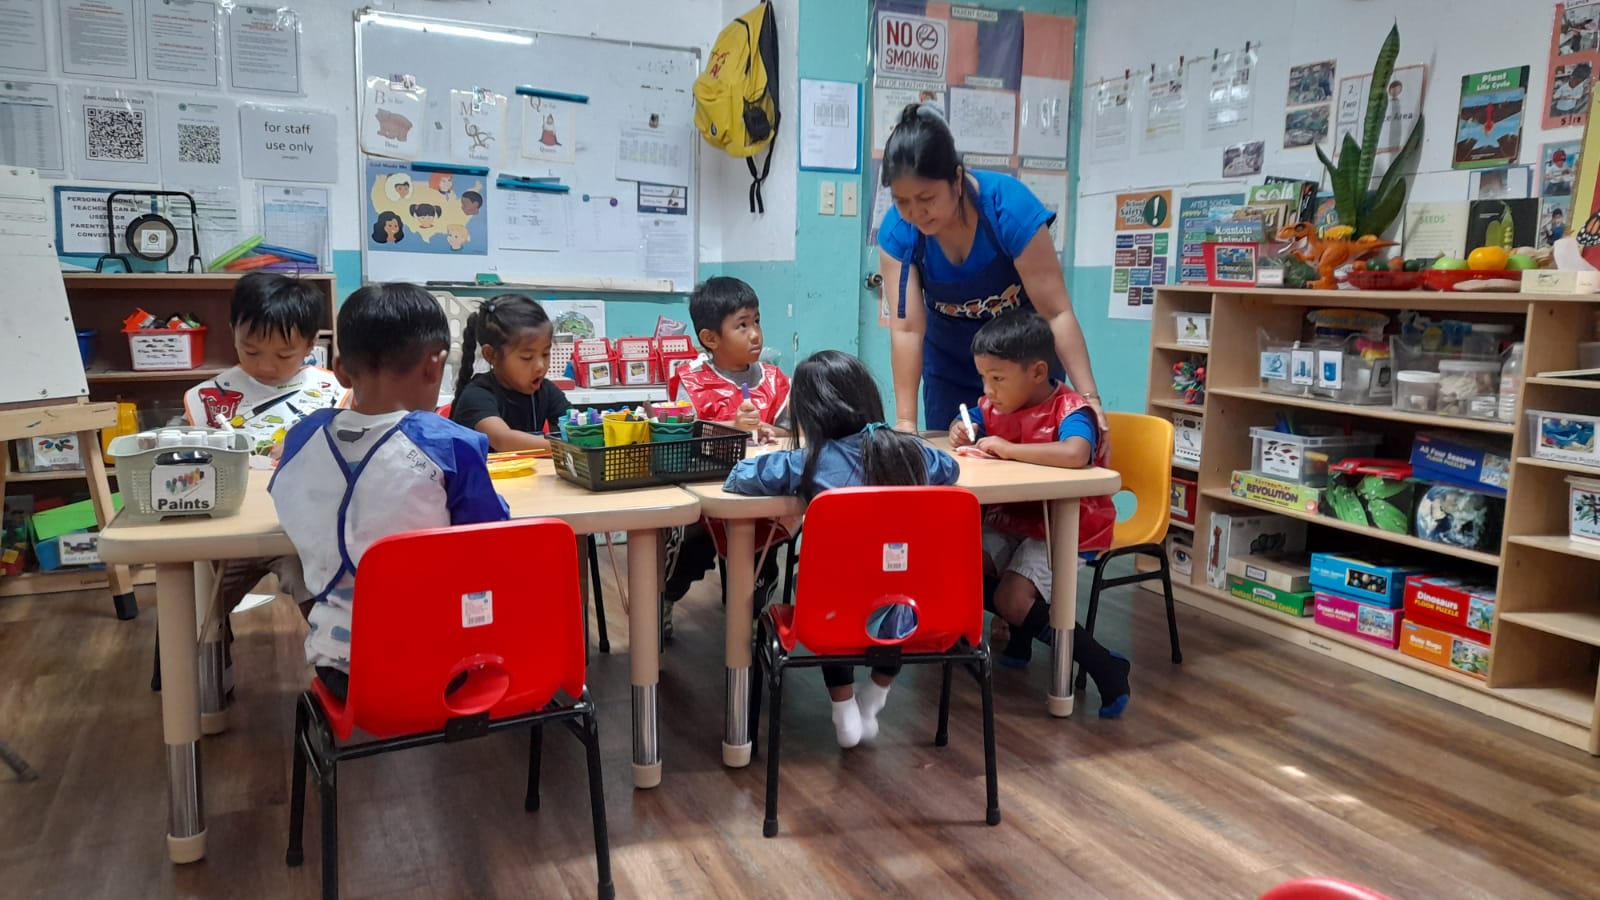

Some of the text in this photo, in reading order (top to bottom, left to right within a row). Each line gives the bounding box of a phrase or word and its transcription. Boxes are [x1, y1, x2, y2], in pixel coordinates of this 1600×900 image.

[886, 19, 913, 47] NO
[885, 48, 939, 70] SMOKING
[1481, 72, 1507, 83] Plant
[375, 90, 385, 104] B
[530, 96, 541, 112] Q
[460, 101, 473, 116] M
[264, 121, 312, 135] for staff
[265, 140, 314, 154] use only
[67, 196, 107, 204] PERSONAL
[1215, 225, 1253, 235] Mountain
[1430, 448, 1446, 458] Four
[1447, 452, 1476, 467] Seasons
[1246, 483, 1299, 503] REVOLUTION
[158, 498, 210, 510] Paints
[1416, 590, 1458, 610] Dinosaurs
[1414, 599, 1459, 617] FLOOR PUZZLE
